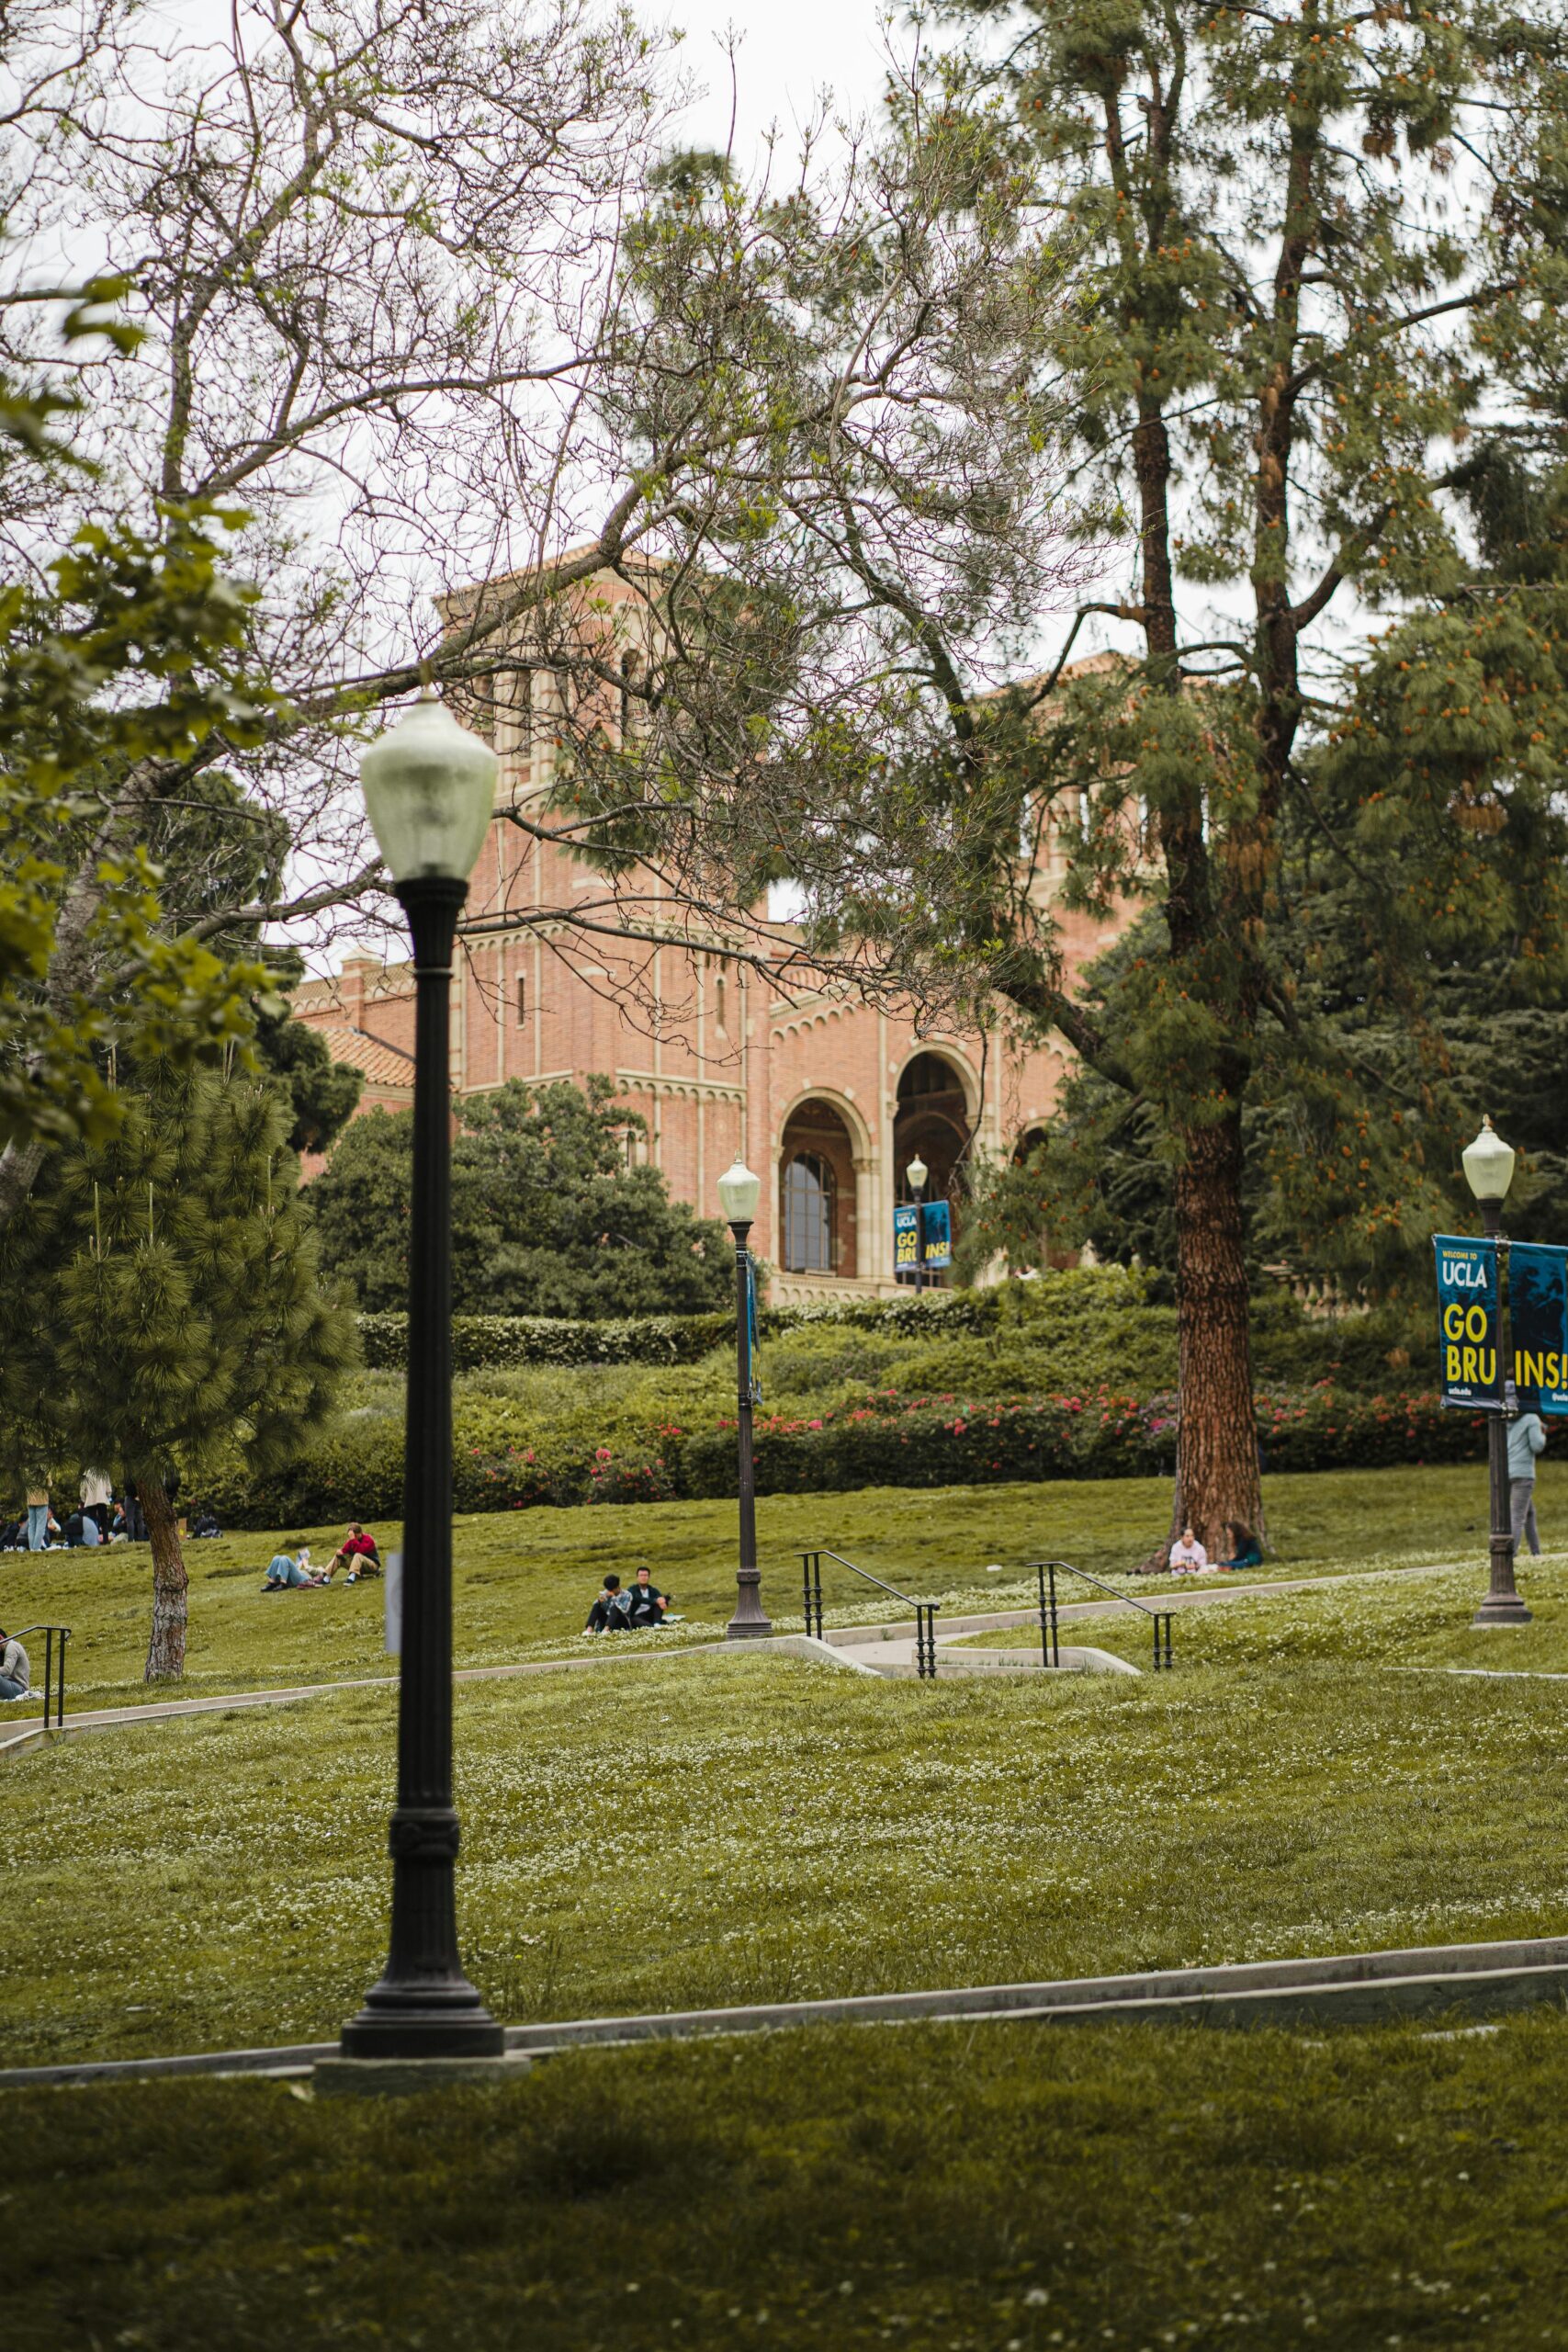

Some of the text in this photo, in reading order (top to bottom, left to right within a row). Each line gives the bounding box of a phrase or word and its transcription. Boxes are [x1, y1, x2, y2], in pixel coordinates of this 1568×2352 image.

[897, 1216, 917, 1227] UCLA
[897, 1231, 917, 1248] GO
[1443, 1250, 1477, 1261] WELCOME TO
[1443, 1261, 1487, 1288] UCLA
[1444, 1304, 1487, 1342] GO
[1447, 1345, 1567, 1389] BRU INS!
